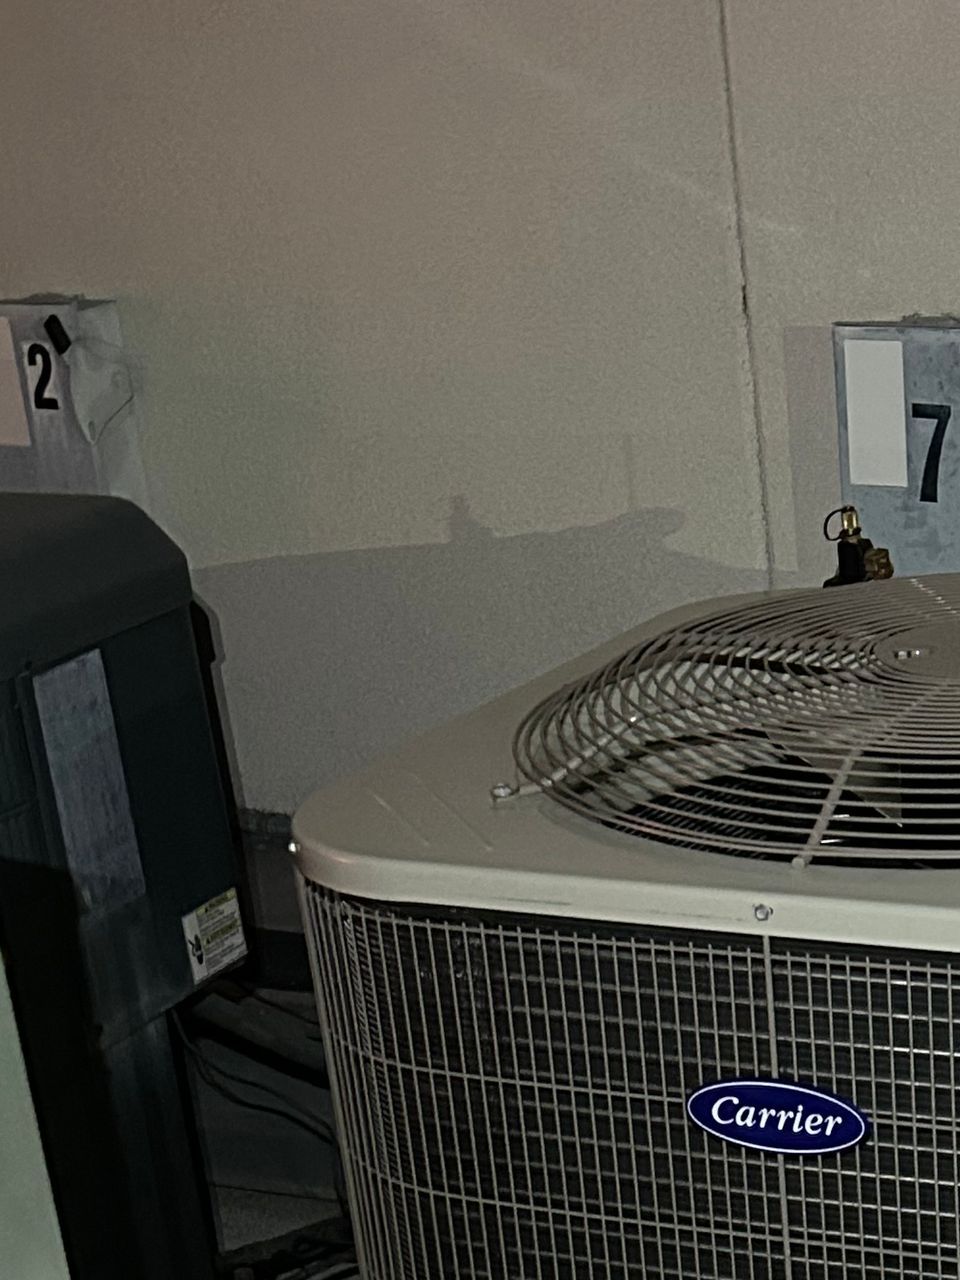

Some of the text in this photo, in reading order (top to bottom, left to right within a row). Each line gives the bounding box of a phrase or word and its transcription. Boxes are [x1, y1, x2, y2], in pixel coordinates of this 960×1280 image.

[27, 343, 59, 410] 2
[912, 403, 951, 503] 7
[710, 1096, 843, 1137] Carrier
